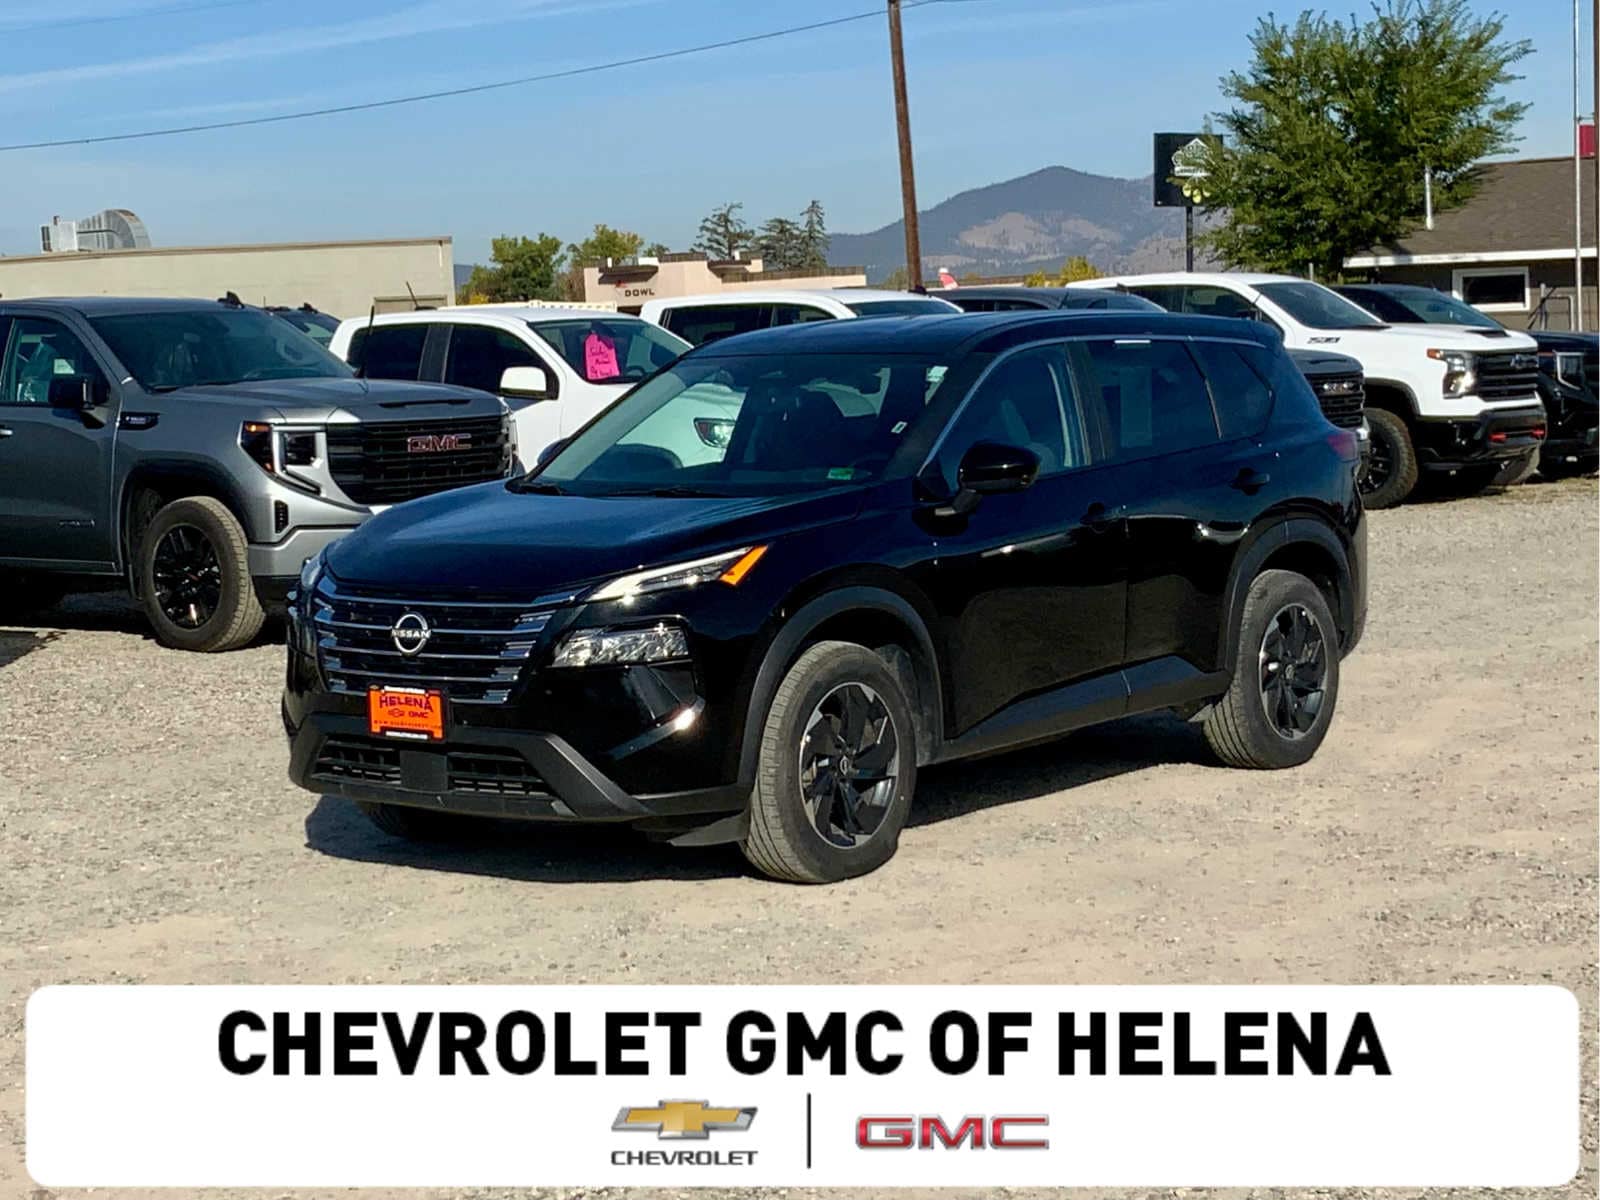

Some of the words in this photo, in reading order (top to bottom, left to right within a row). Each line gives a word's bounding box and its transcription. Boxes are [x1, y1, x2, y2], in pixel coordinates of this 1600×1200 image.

[624, 288, 655, 297] DOWL
[407, 433, 472, 452] GMC
[391, 628, 432, 639] NISSAN
[379, 695, 434, 713] HELENA
[408, 711, 429, 719] GMC
